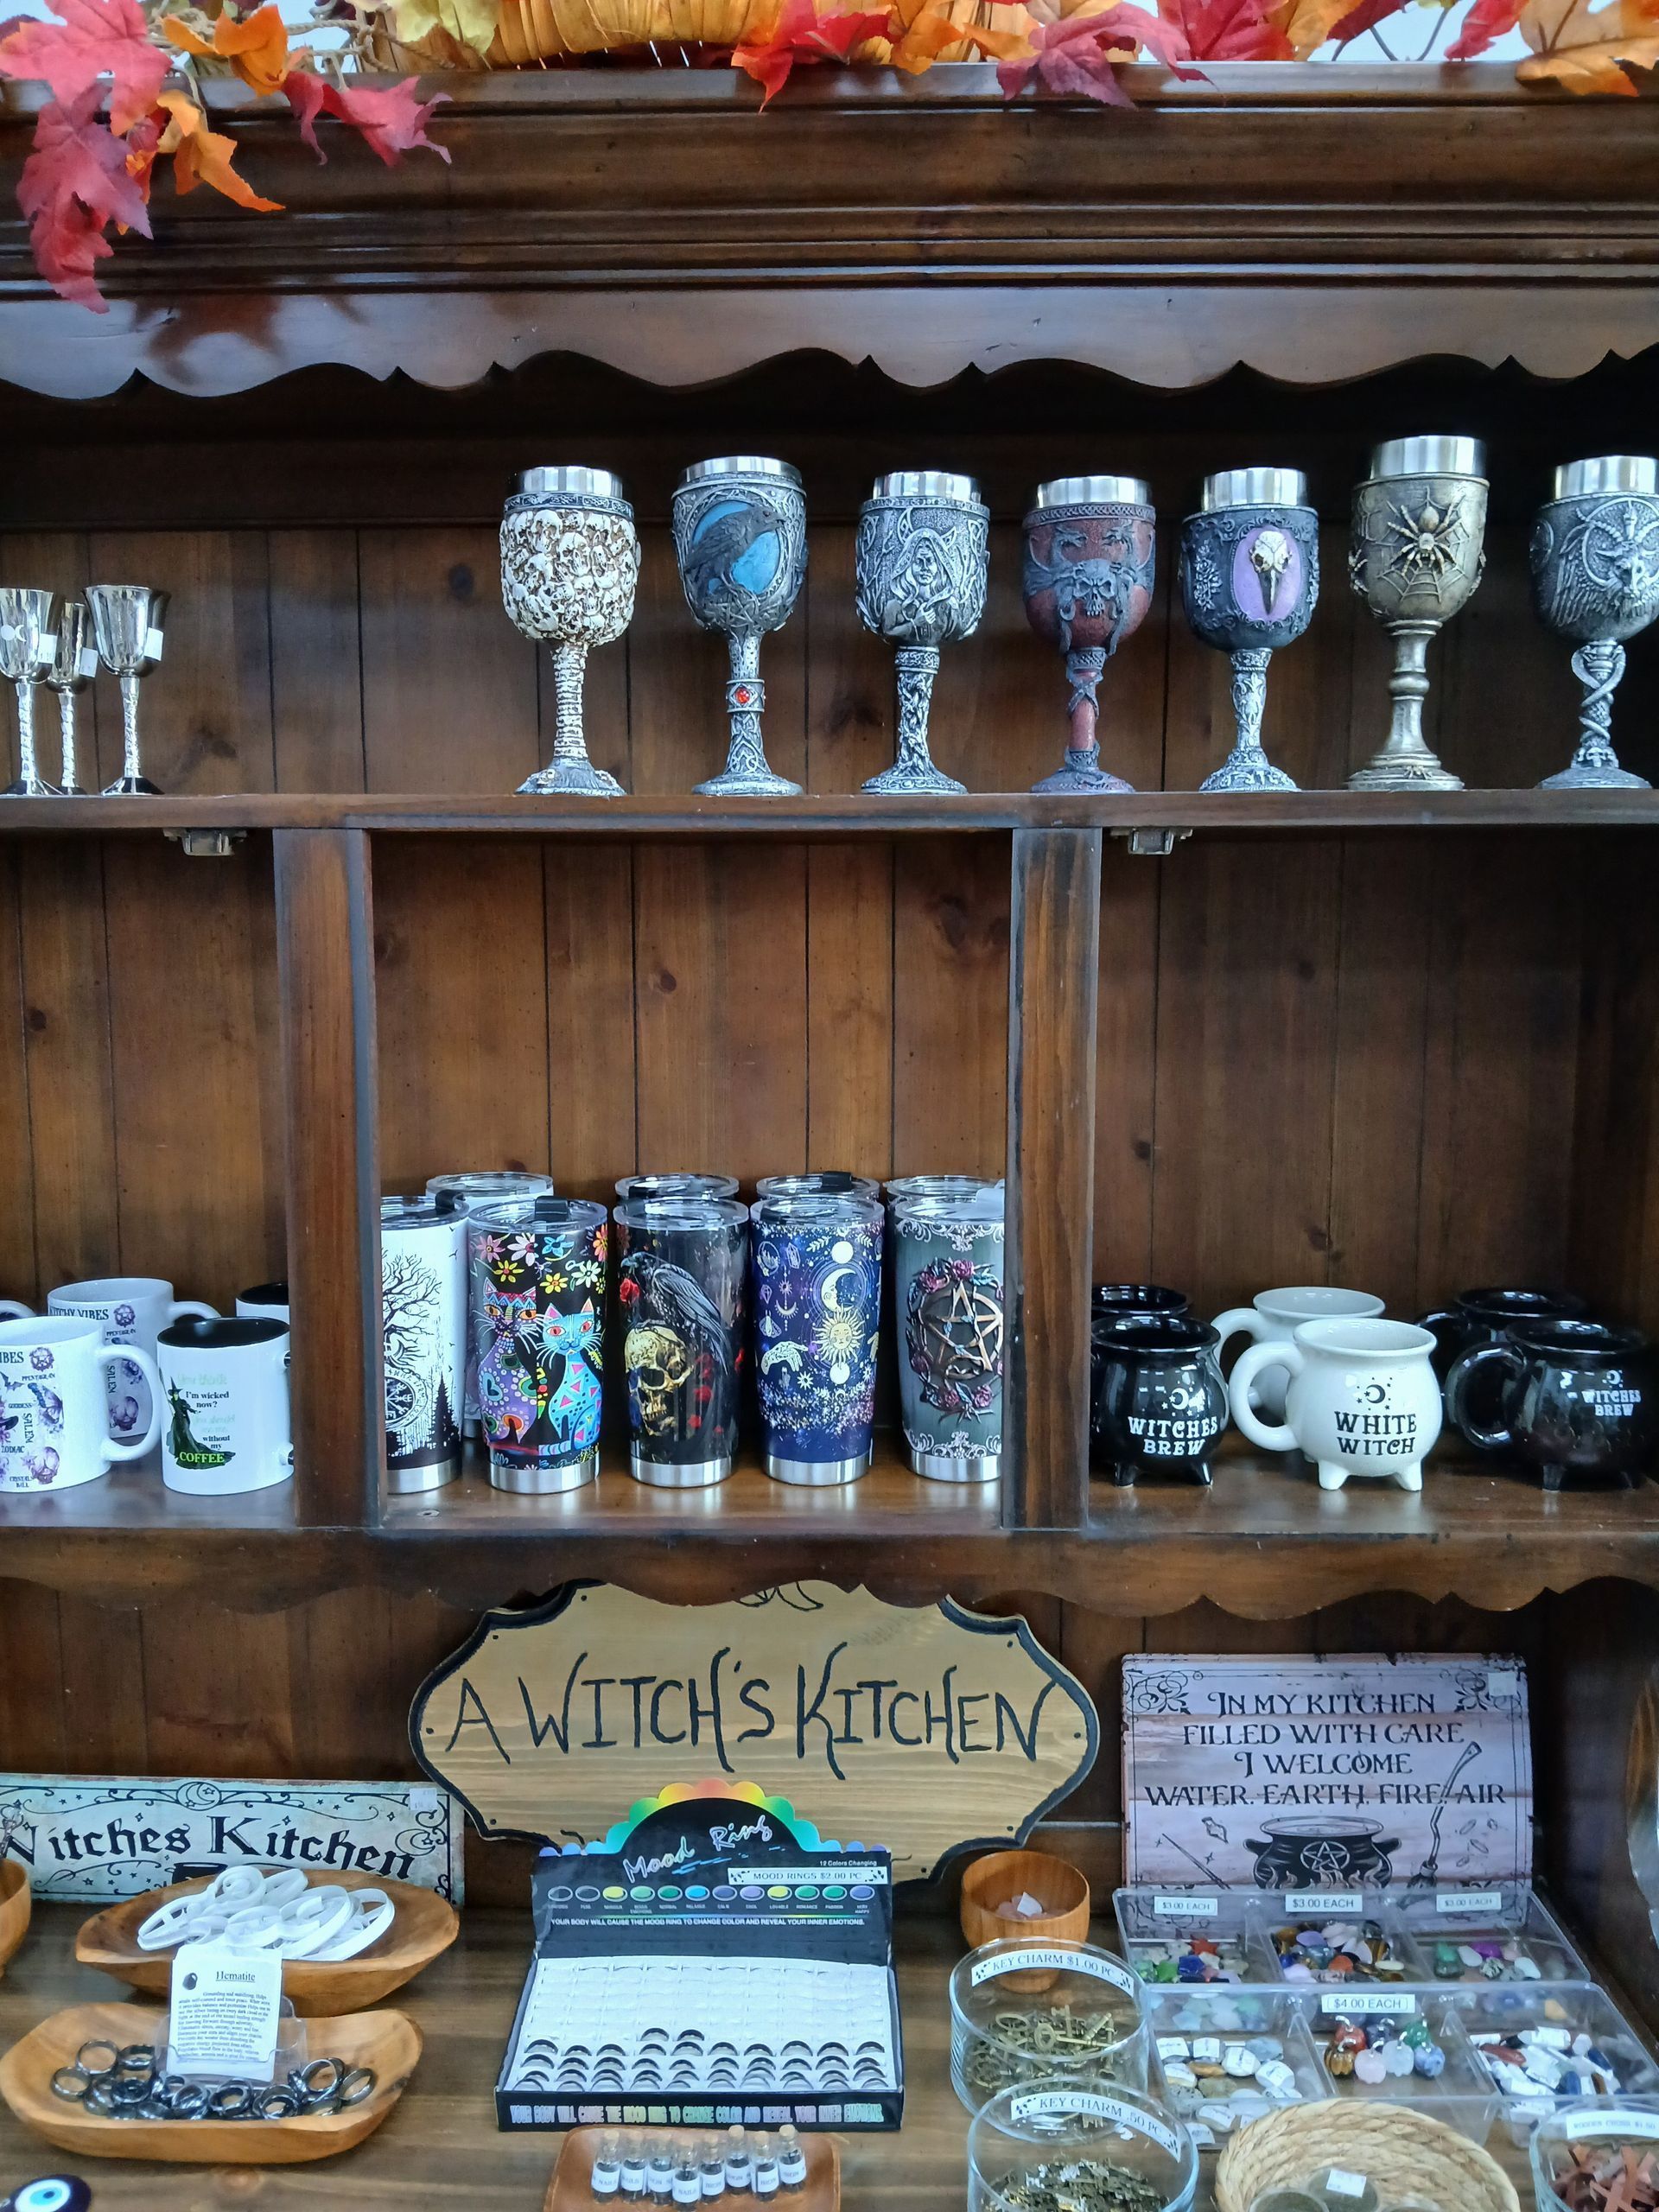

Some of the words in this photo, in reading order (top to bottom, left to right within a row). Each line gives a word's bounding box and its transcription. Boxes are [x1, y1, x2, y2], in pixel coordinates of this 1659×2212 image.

[1581, 1389, 1642, 1403] WITCHES
[1594, 1403, 1634, 1416] BREW
[1128, 1416, 1218, 1439] WITCHES
[1334, 1411, 1417, 1435] WHITE
[1143, 1439, 1205, 1456] BREW
[1337, 1437, 1415, 1456] WITCH
[179, 1452, 225, 1463] COFFEE
[445, 1677, 512, 1764] A
[518, 1647, 775, 1773] WITCH'S
[797, 1642, 1057, 1780] KITCHEN
[1207, 1692, 1247, 1718] IN
[1254, 1694, 1298, 1714] MY
[1306, 1691, 1436, 1715] KITCHEN
[1182, 1724, 1281, 1745] FILLED
[1289, 1724, 1377, 1744] WITH
[1383, 1723, 1465, 1744] CARE
[1234, 1751, 1254, 1778] I
[1262, 1751, 1414, 1774] WELCOME
[1455, 1783, 1507, 1804] AIR
[207, 1815, 416, 1881] Kitchen
[623, 1836, 696, 1884] Mood
[787, 1872, 817, 1880] RINGS
[820, 1872, 846, 1880] $2.00
[1323, 1898, 1354, 1908] EACH
[1468, 1897, 1492, 1906] EACH
[216, 1971, 256, 1982] Hematite
[993, 1957, 1014, 1971] KEY
[1018, 1955, 1064, 1965] CHARM
[1066, 1955, 1098, 1972] $1.00
[1101, 1966, 1115, 1977] PC
[1333, 1999, 1365, 2009] $4.00
[1368, 1999, 1402, 2009] EACH
[1039, 2097, 1067, 2109] KEY
[1071, 2097, 1122, 2117] CHARM
[1147, 2123, 1163, 2138] PC
